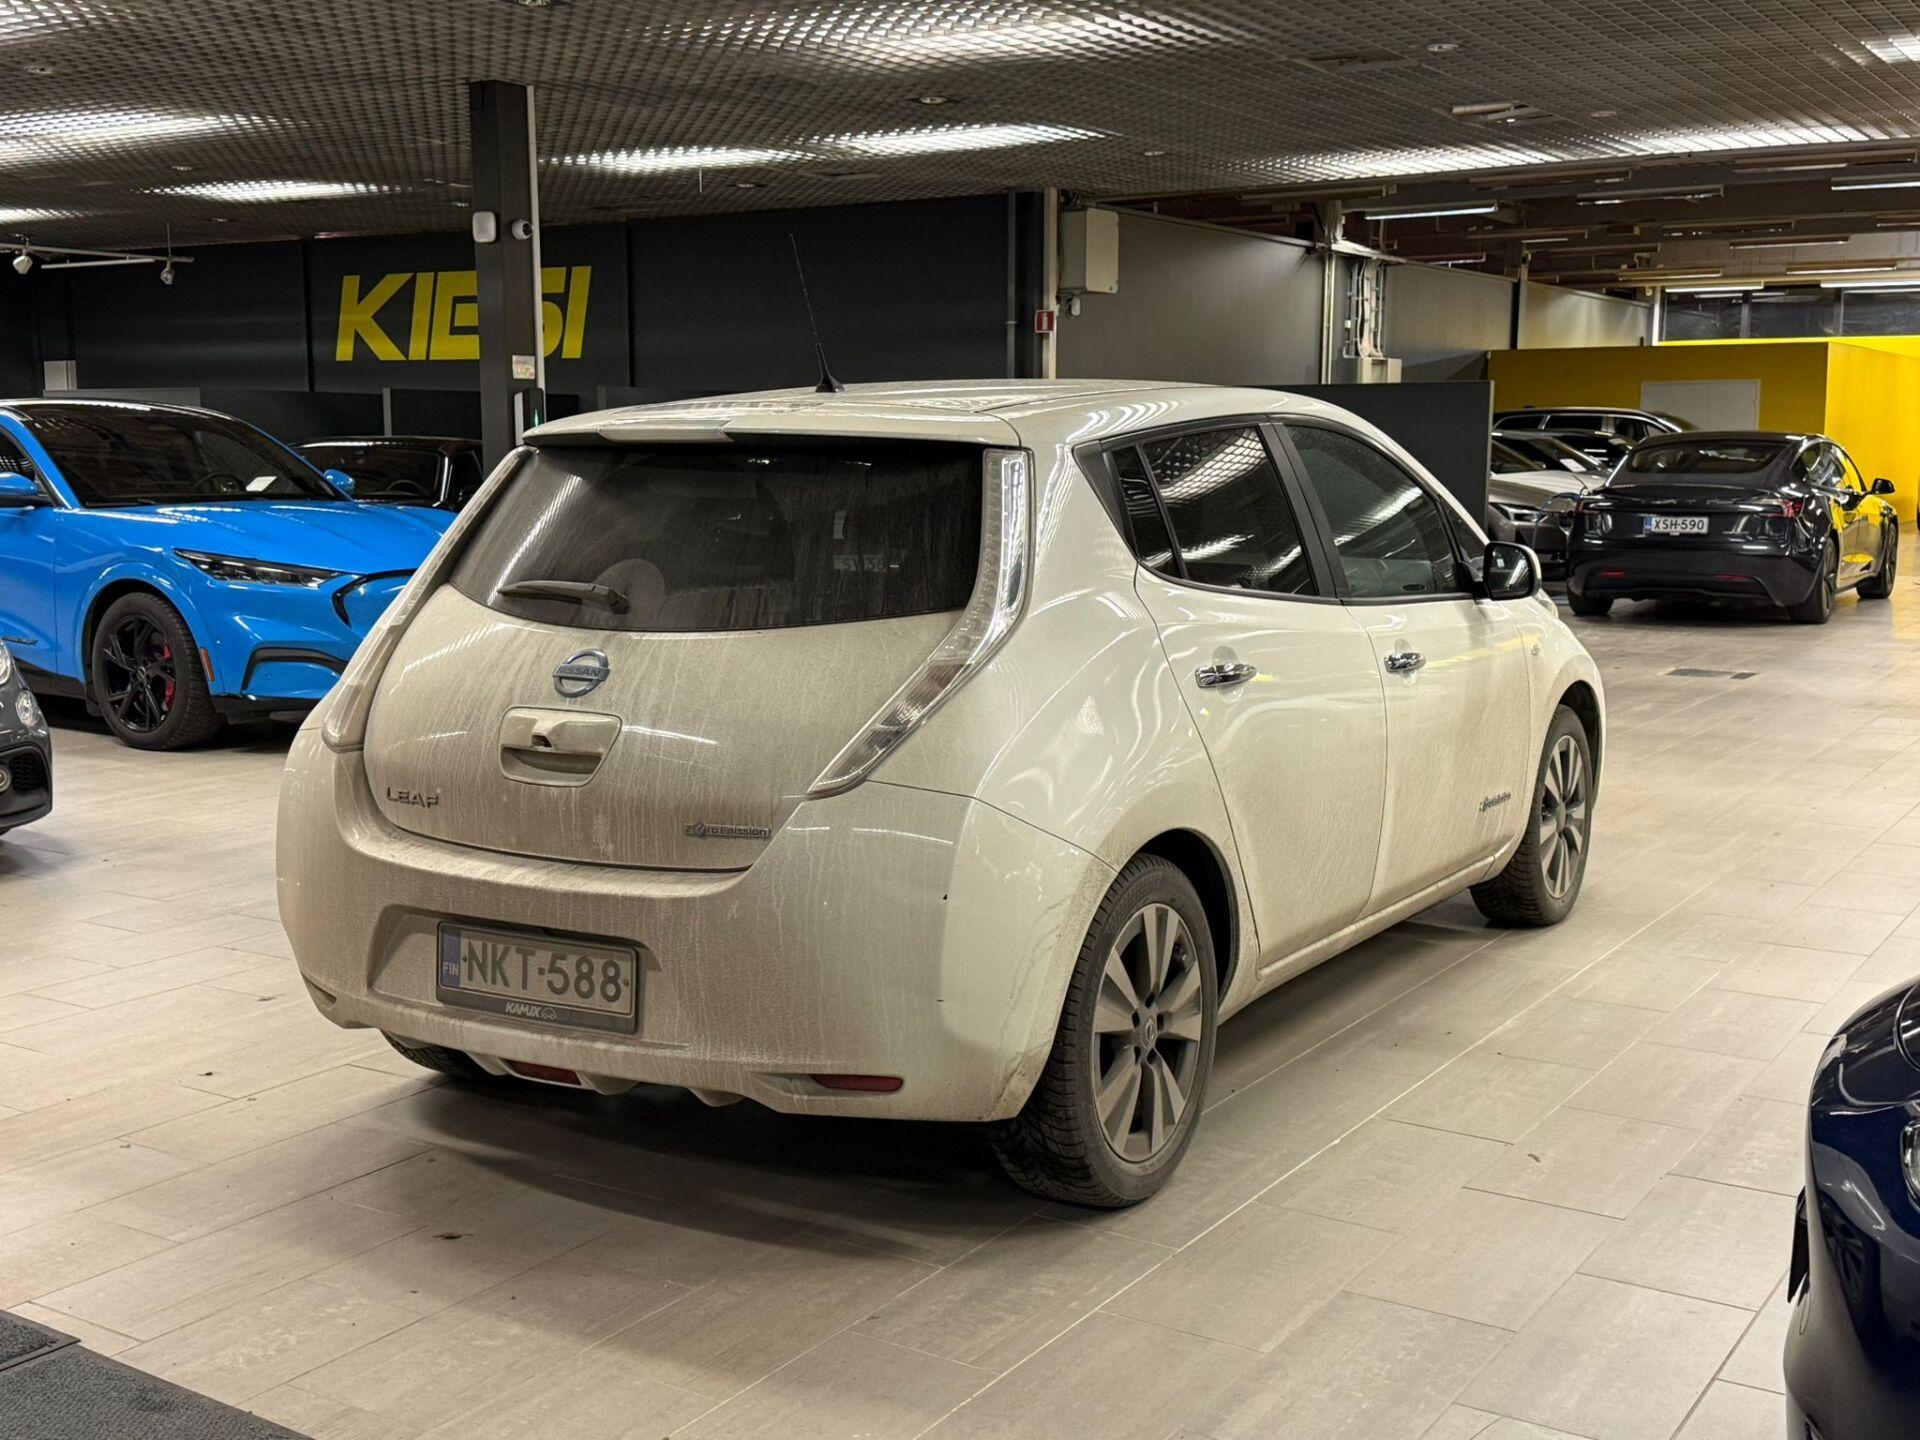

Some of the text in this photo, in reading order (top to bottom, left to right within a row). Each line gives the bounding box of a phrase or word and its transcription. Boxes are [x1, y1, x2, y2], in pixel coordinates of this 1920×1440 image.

[1654, 519, 1705, 531] XSH-590
[560, 665, 602, 677] NISSAN
[387, 786, 439, 808] LEAF
[443, 961, 459, 976] FIN
[467, 939, 622, 1003] NKT-588
